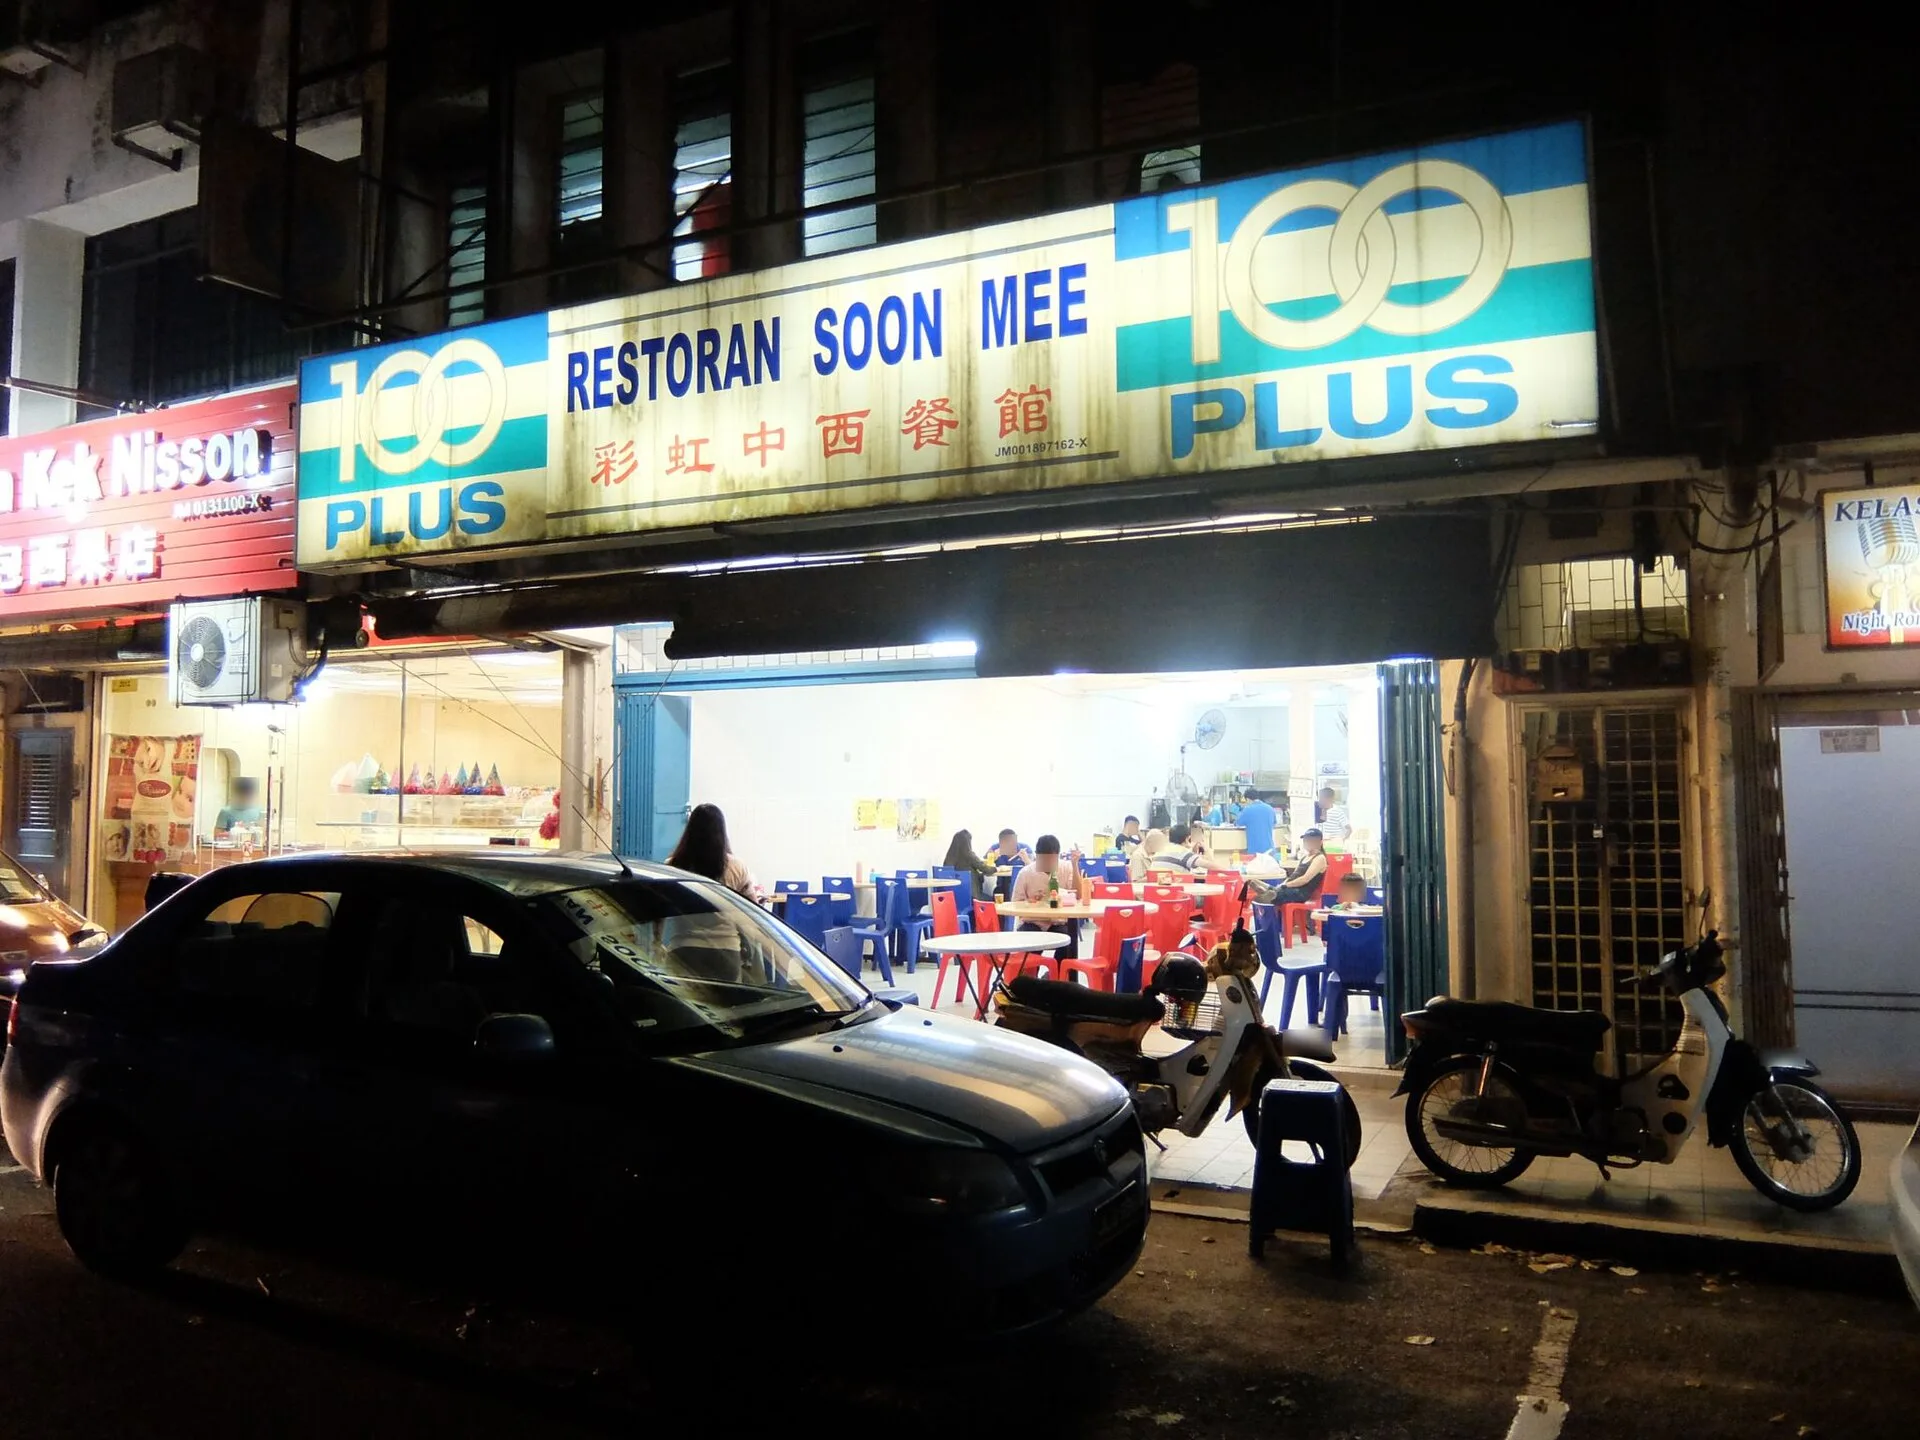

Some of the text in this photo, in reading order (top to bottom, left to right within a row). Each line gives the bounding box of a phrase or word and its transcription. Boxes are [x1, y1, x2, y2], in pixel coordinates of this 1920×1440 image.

[1167, 158, 1513, 365] 100
[567, 263, 1088, 413] RESTORAN SOON MEE
[330, 338, 508, 482] 100
[591, 384, 1052, 487] 彩虹中西餐館
[1170, 354, 1519, 460] PLUS
[22, 441, 102, 509] Kek
[111, 428, 260, 496] Nisson
[326, 481, 506, 550] PLUS
[1843, 611, 1885, 634] Night
